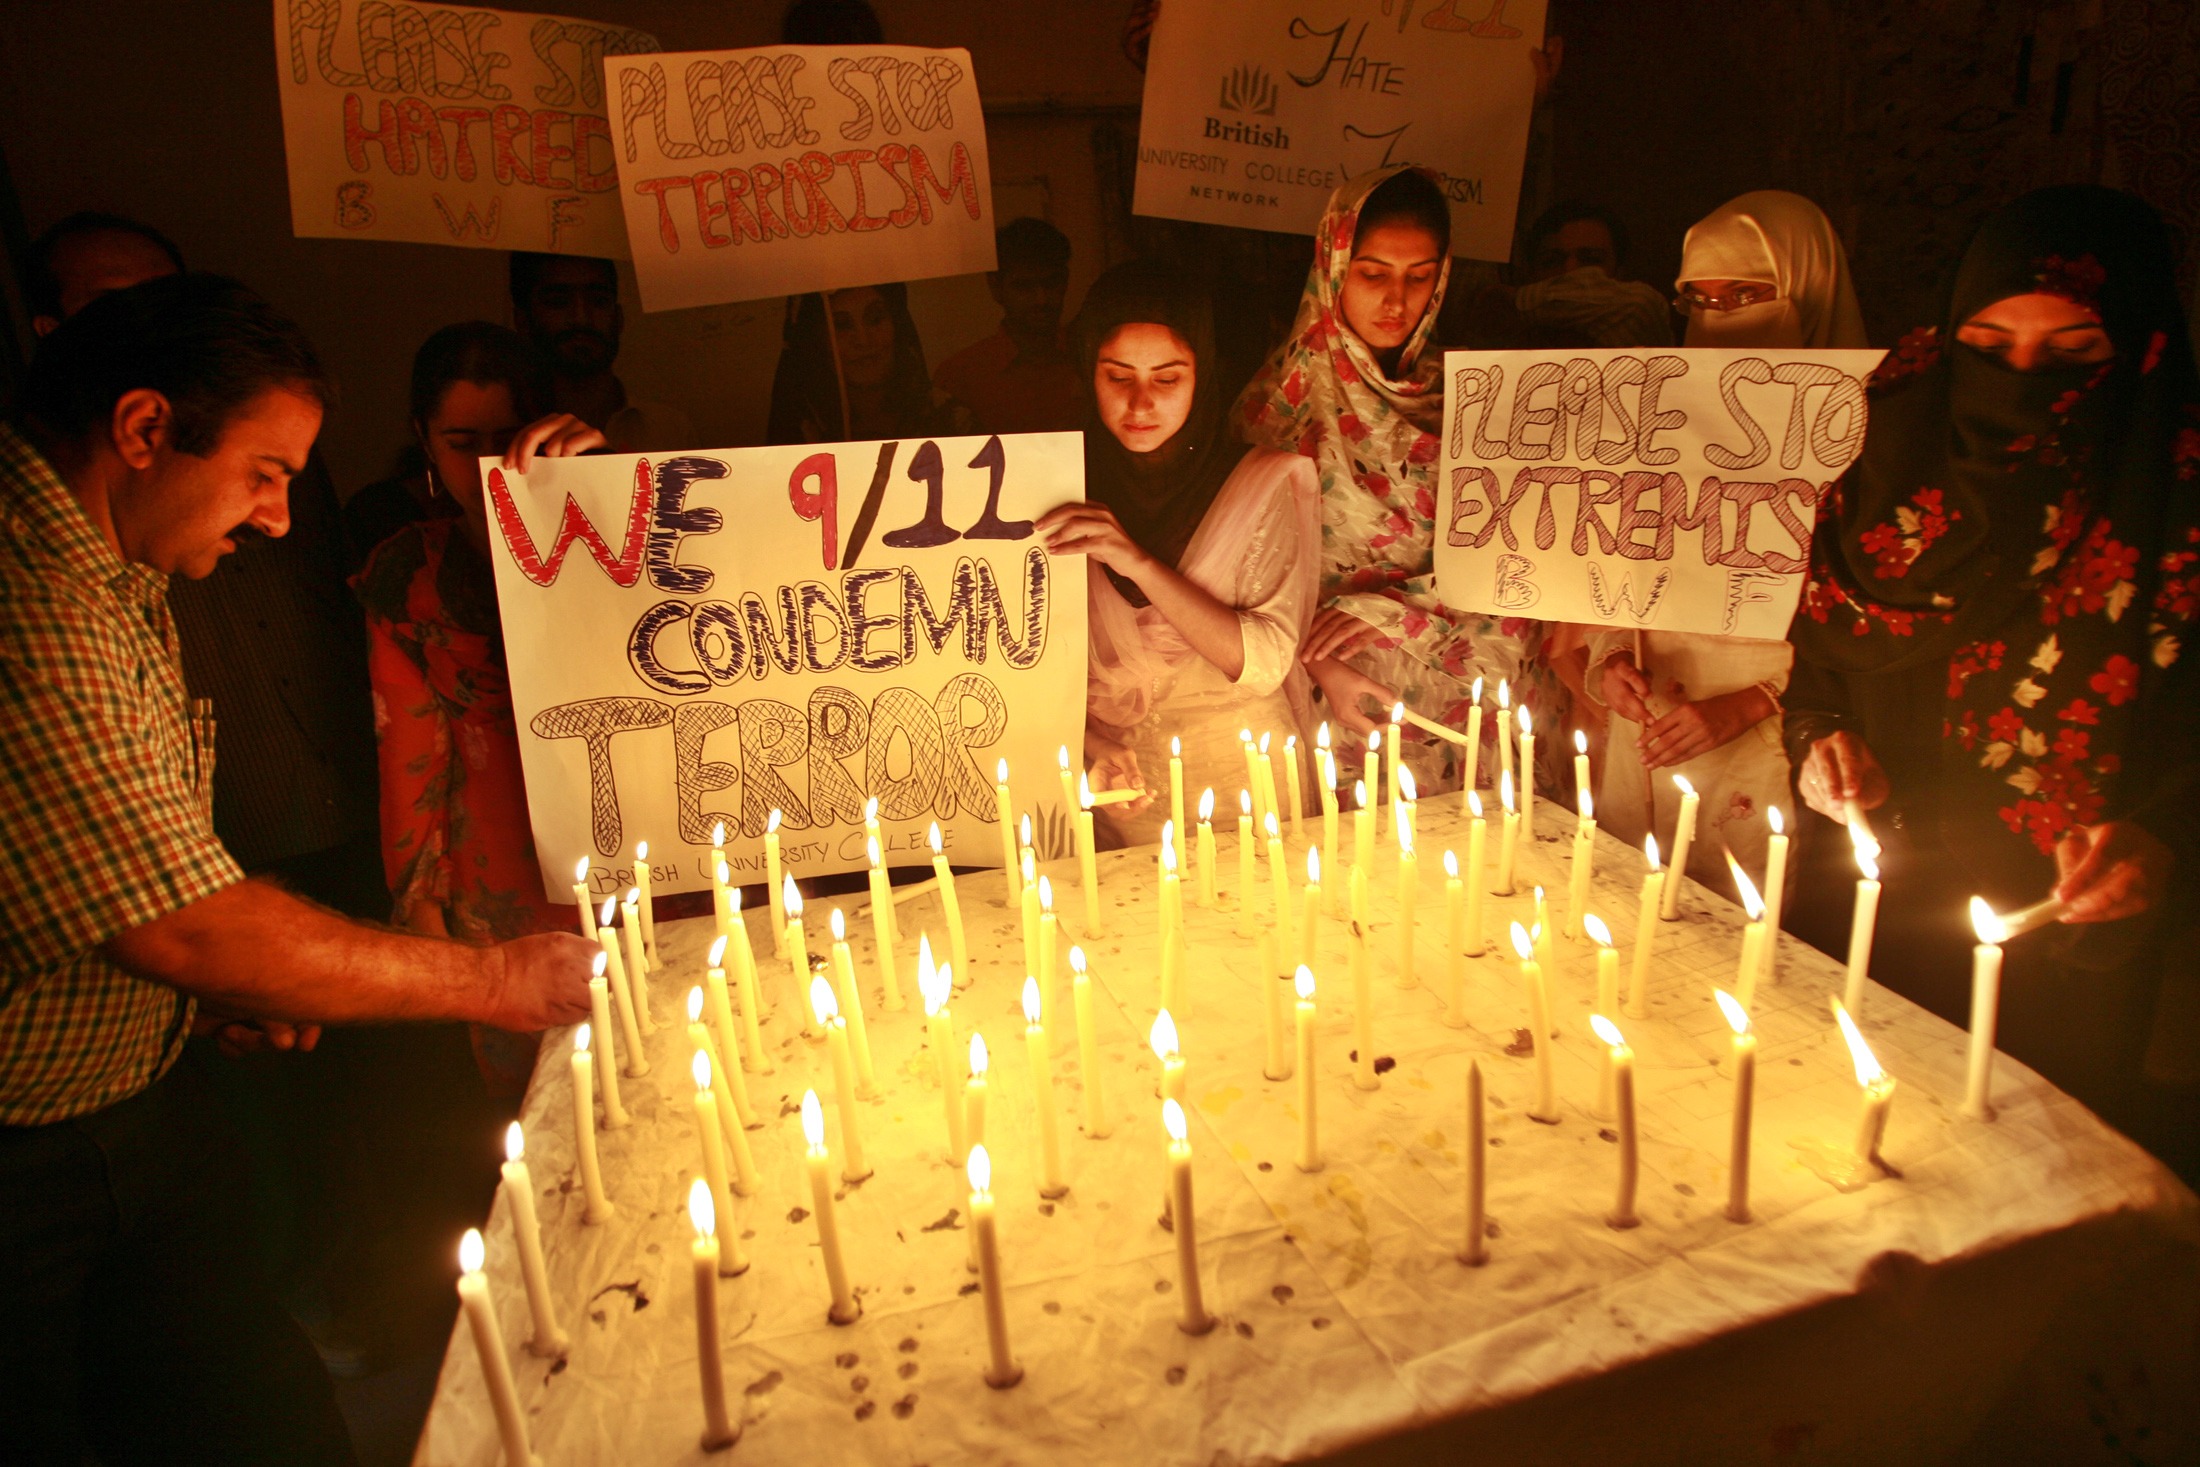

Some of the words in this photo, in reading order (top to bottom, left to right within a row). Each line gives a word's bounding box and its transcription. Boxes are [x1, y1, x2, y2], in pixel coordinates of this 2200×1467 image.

[288, 0, 511, 100] PLEASE
[530, 18, 661, 109] ST
[619, 54, 821, 163] PLEASE
[828, 56, 963, 141] STOP
[344, 92, 619, 193] HATRED
[1139, 147, 1229, 175] UNIVERSITY
[1245, 162, 1335, 189] COLLEGE
[1204, 116, 1290, 150] British
[334, 180, 377, 231] B
[433, 191, 502, 242] W
[546, 194, 590, 250] F
[635, 142, 981, 254] TERRORISM
[1190, 184, 1279, 208] NETWORK
[1450, 355, 1689, 466] PLEASE
[488, 456, 732, 595] WE
[789, 435, 1035, 571] 9/11
[627, 546, 1050, 696] CONDEMN
[1493, 553, 1541, 609] B
[1587, 561, 1673, 624] W
[1721, 569, 1787, 634] F
[530, 673, 1008, 857] TERROR
